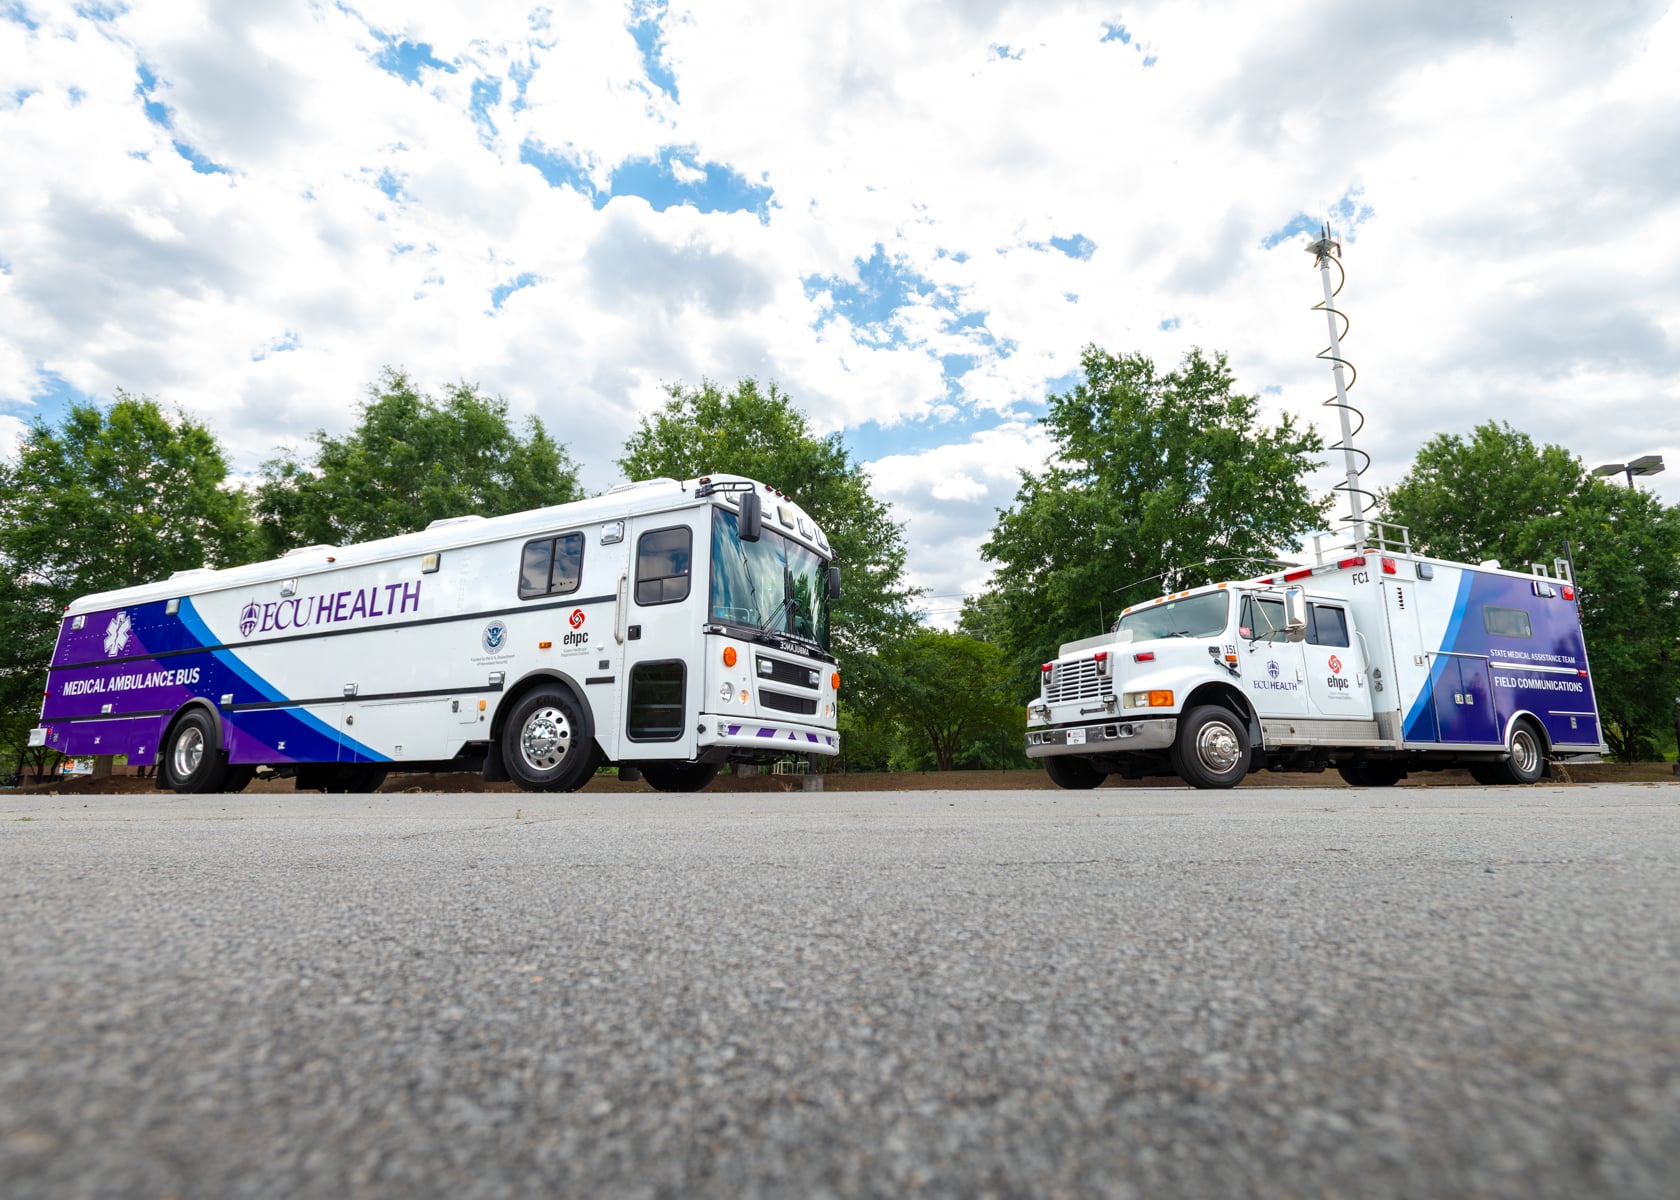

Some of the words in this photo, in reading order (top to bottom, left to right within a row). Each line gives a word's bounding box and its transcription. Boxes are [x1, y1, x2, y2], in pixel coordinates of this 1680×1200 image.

[1352, 571, 1370, 586] FC1
[259, 596, 315, 633] ECU
[315, 580, 422, 625] HEALTH
[563, 631, 589, 647] ehpc
[1225, 645, 1236, 654] 151
[1490, 649, 1507, 657] STATE
[1507, 651, 1530, 659] MEDICAL
[1531, 653, 1562, 663] ASSISTANCE
[1562, 656, 1576, 664] TEAM
[63, 678, 106, 697] MEDICAL
[107, 670, 175, 692] AMBULANCE
[175, 667, 200, 685] BUS
[1253, 680, 1270, 690] ECU
[1270, 681, 1298, 691] HEALTH
[1327, 675, 1349, 691] ehpc
[1494, 676, 1516, 687] FIELD
[1517, 678, 1583, 692] COMMUNICATIONS
